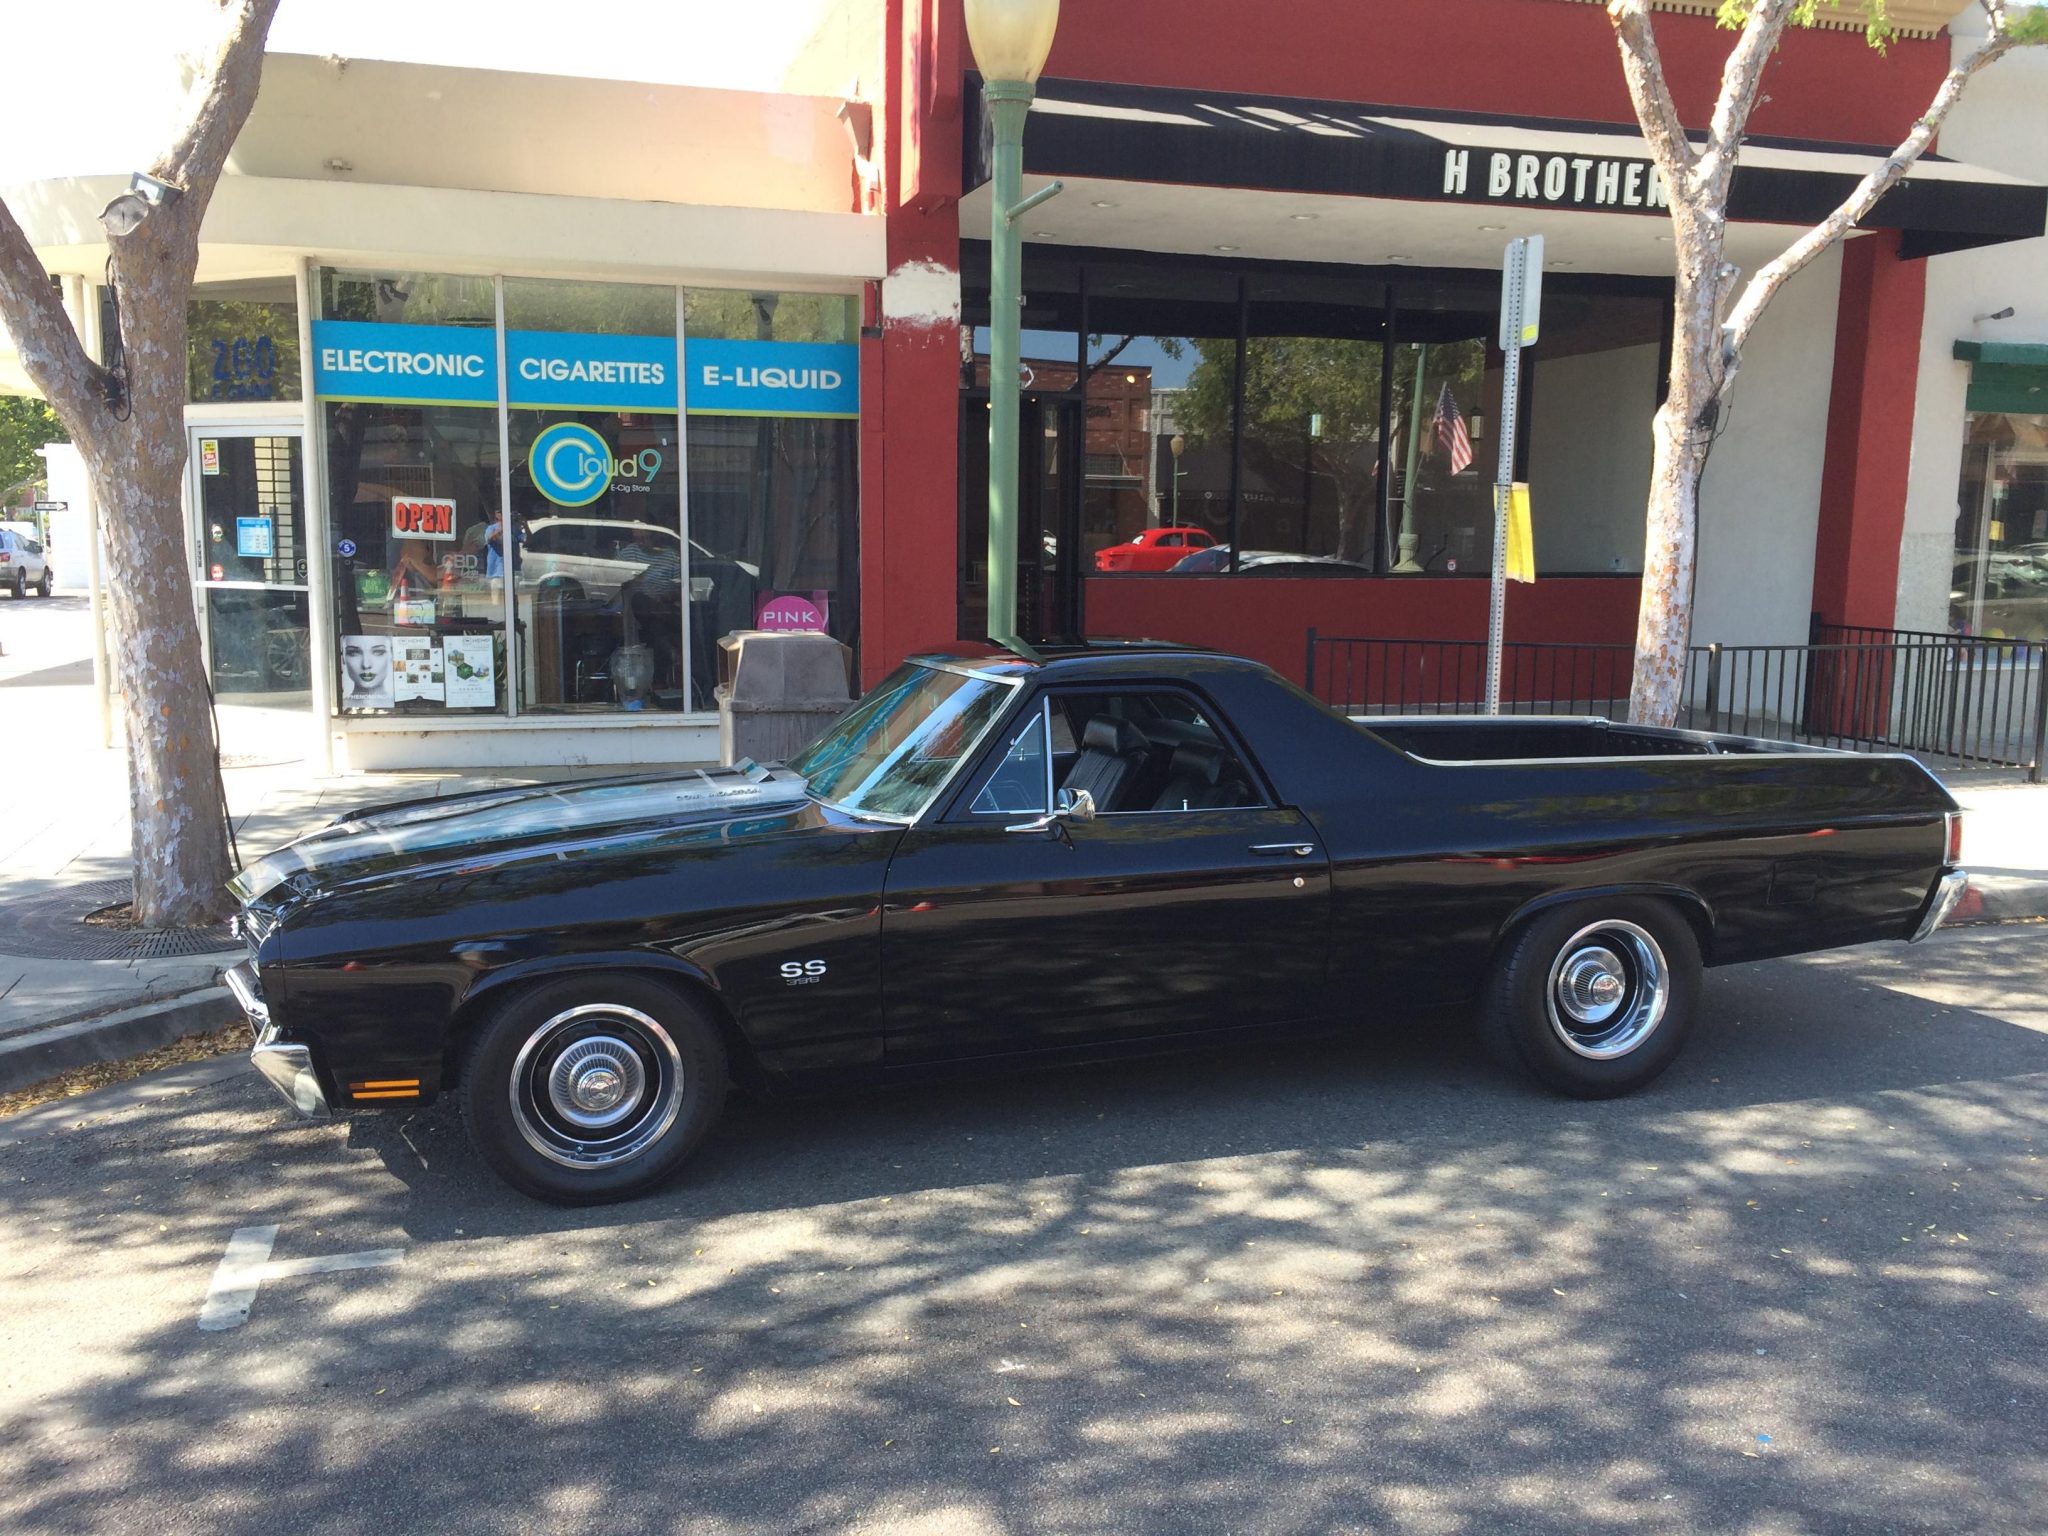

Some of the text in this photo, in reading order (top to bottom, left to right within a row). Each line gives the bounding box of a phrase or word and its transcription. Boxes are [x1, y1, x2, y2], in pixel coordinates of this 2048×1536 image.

[1443, 149, 1669, 208] H BROTHER
[322, 348, 484, 378] ELECTRONIC
[519, 358, 665, 385] CIGARETTES
[703, 365, 841, 389] E-LIQUID
[610, 484, 651, 493] E-Cig Store
[395, 502, 452, 534] OPEN
[441, 554, 478, 568] CBD
[763, 611, 815, 623] PINK
[780, 959, 827, 978] SS
